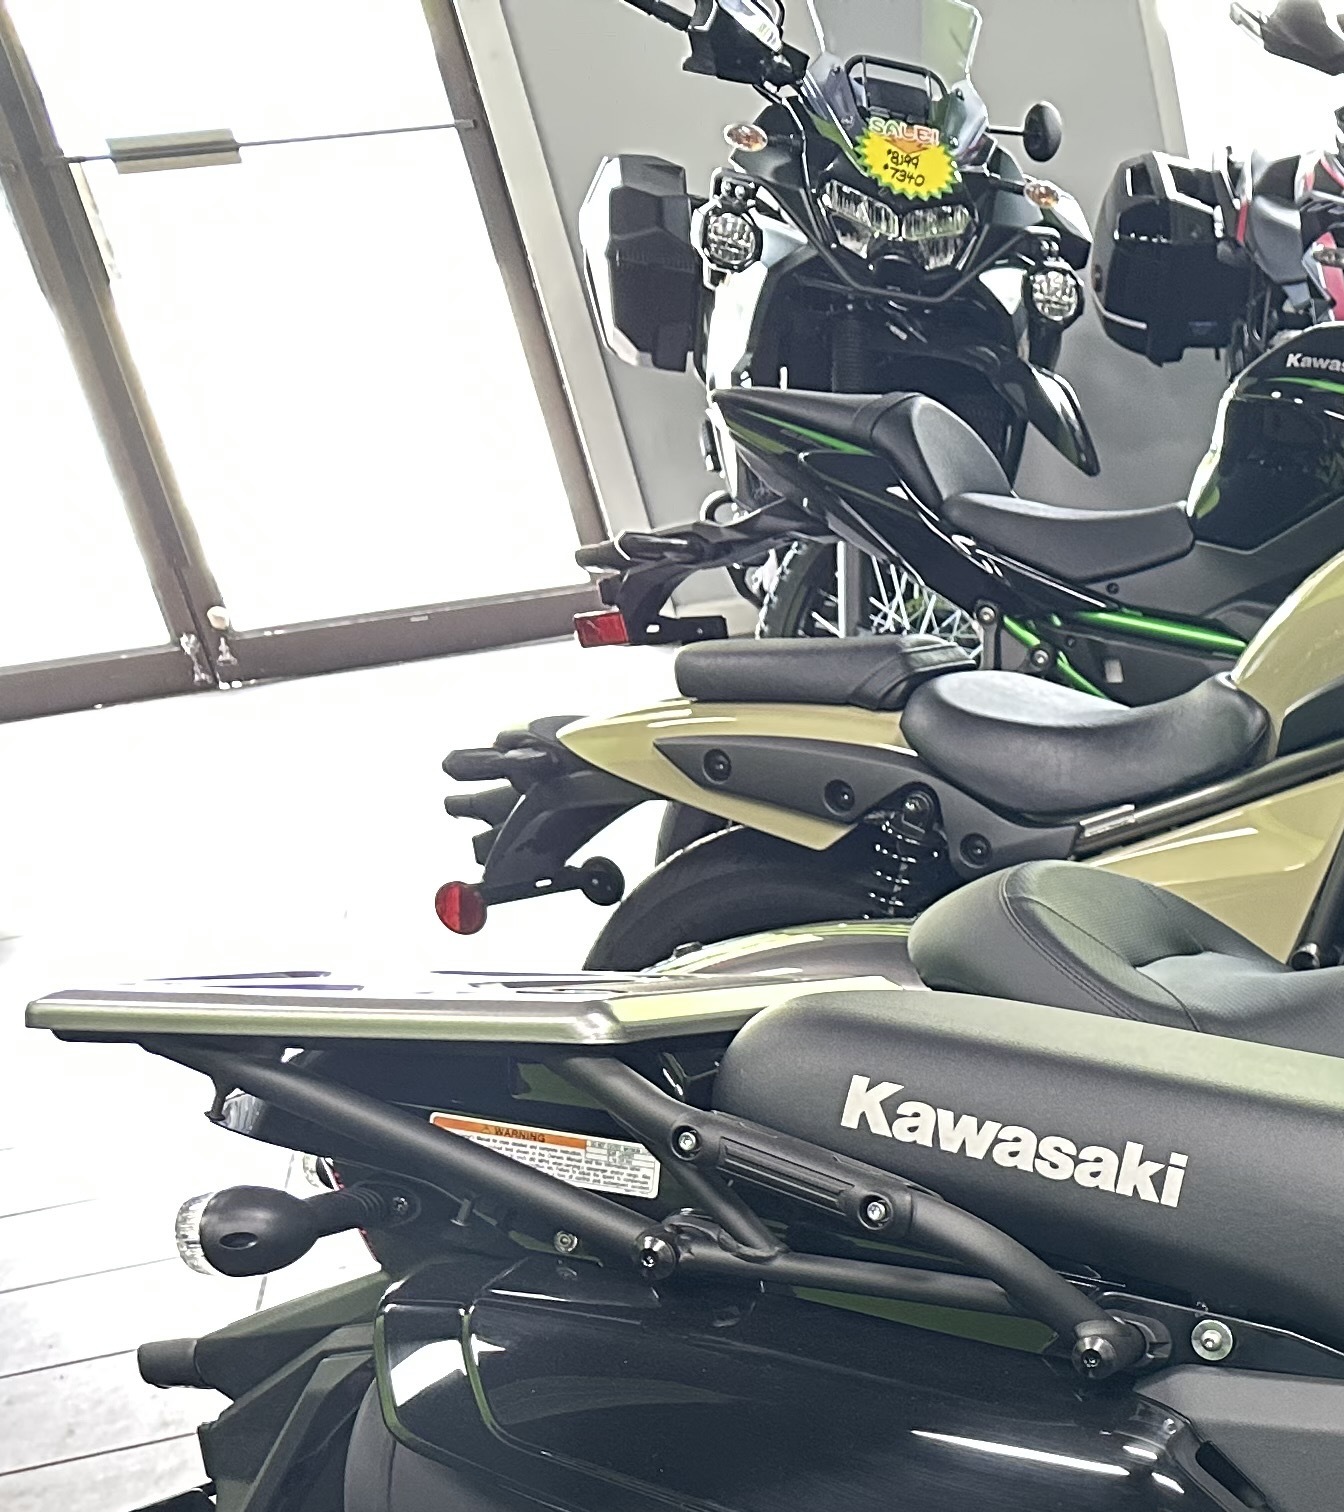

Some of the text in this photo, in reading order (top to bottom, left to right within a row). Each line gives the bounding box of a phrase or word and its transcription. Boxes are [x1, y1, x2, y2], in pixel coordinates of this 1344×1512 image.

[868, 117, 940, 146] SALE!
[494, 1127, 546, 1144] WARNING
[840, 1074, 1189, 1208] Kawasaki
